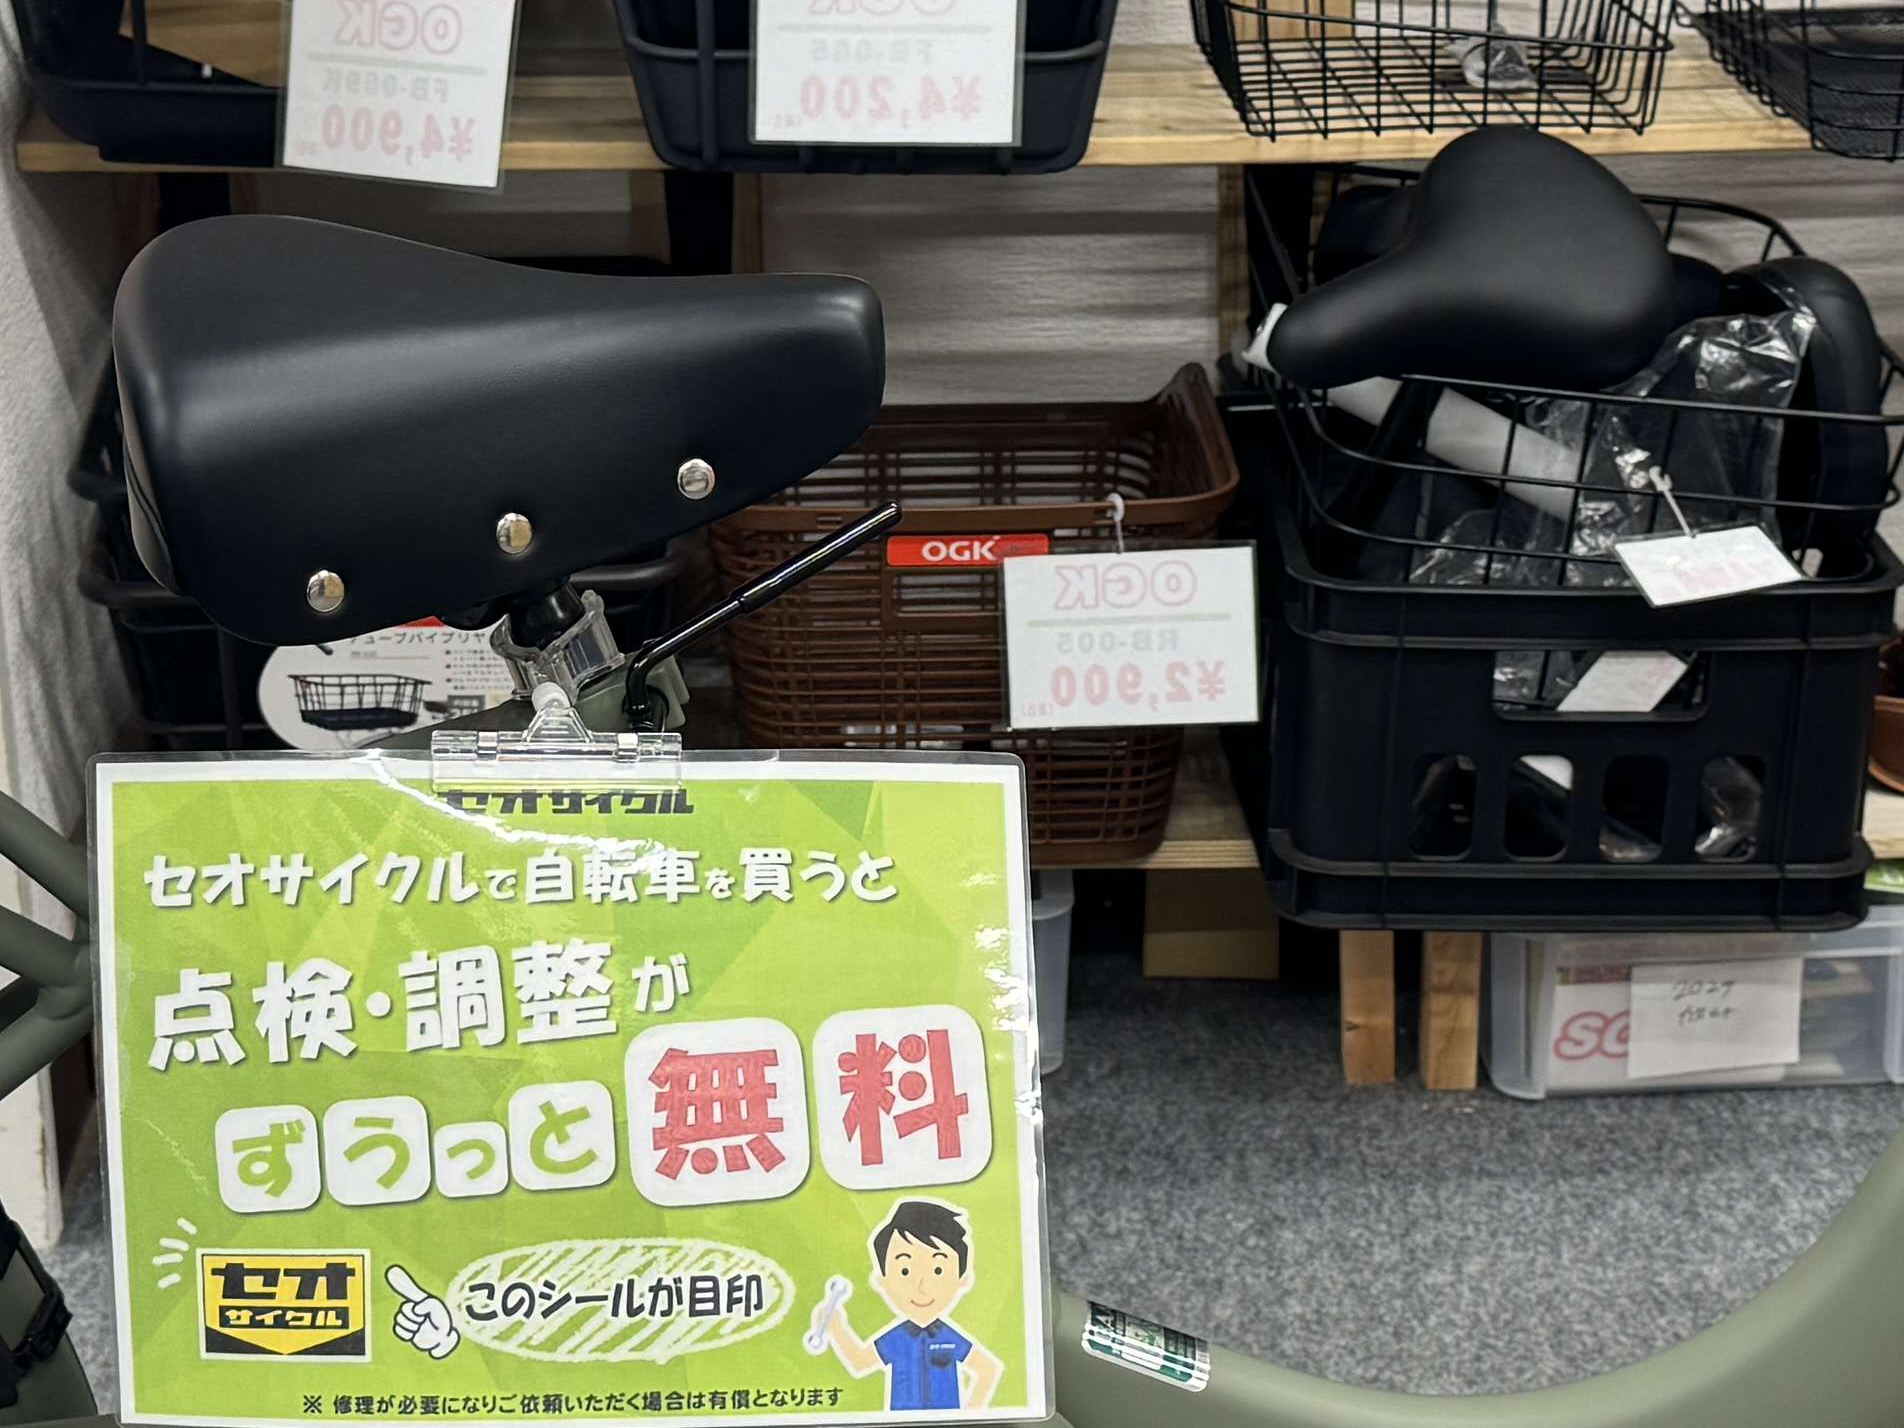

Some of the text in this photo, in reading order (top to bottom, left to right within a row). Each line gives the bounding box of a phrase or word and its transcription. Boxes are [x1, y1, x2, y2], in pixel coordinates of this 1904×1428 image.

[921, 539, 996, 562] OGK
[144, 846, 897, 907] セオサイクルで自転車を買うと
[464, 1274, 766, 1322] このシールが目印
